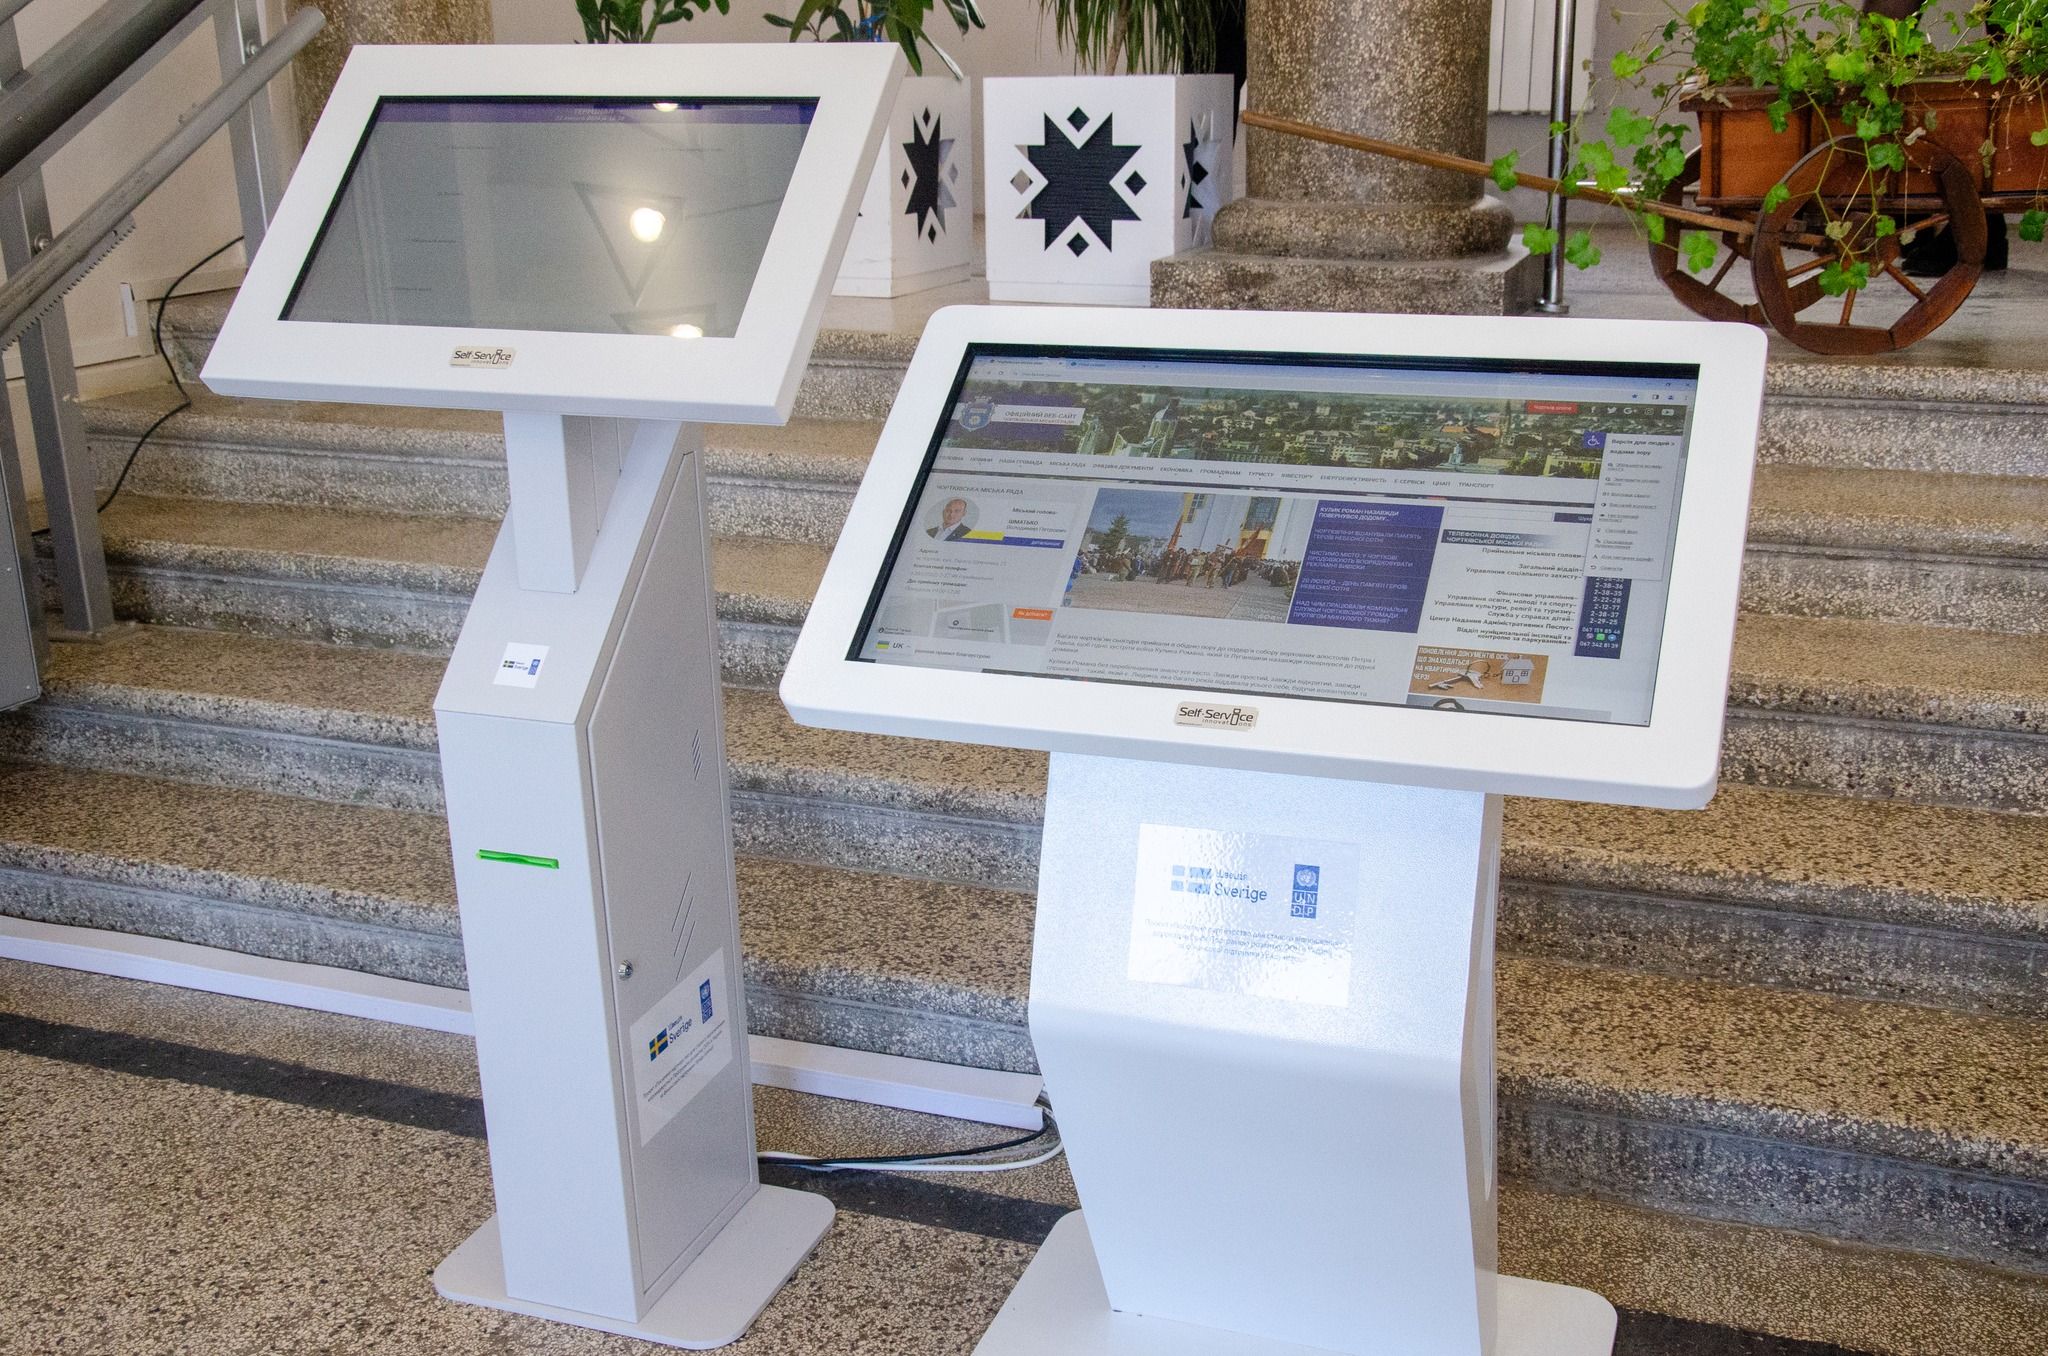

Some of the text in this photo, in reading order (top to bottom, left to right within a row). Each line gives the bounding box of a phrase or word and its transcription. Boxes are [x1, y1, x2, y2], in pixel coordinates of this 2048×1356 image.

[1179, 703, 1254, 726] Self-Service
[1214, 881, 1268, 903] Sverige
[669, 1018, 693, 1045] Sverige
